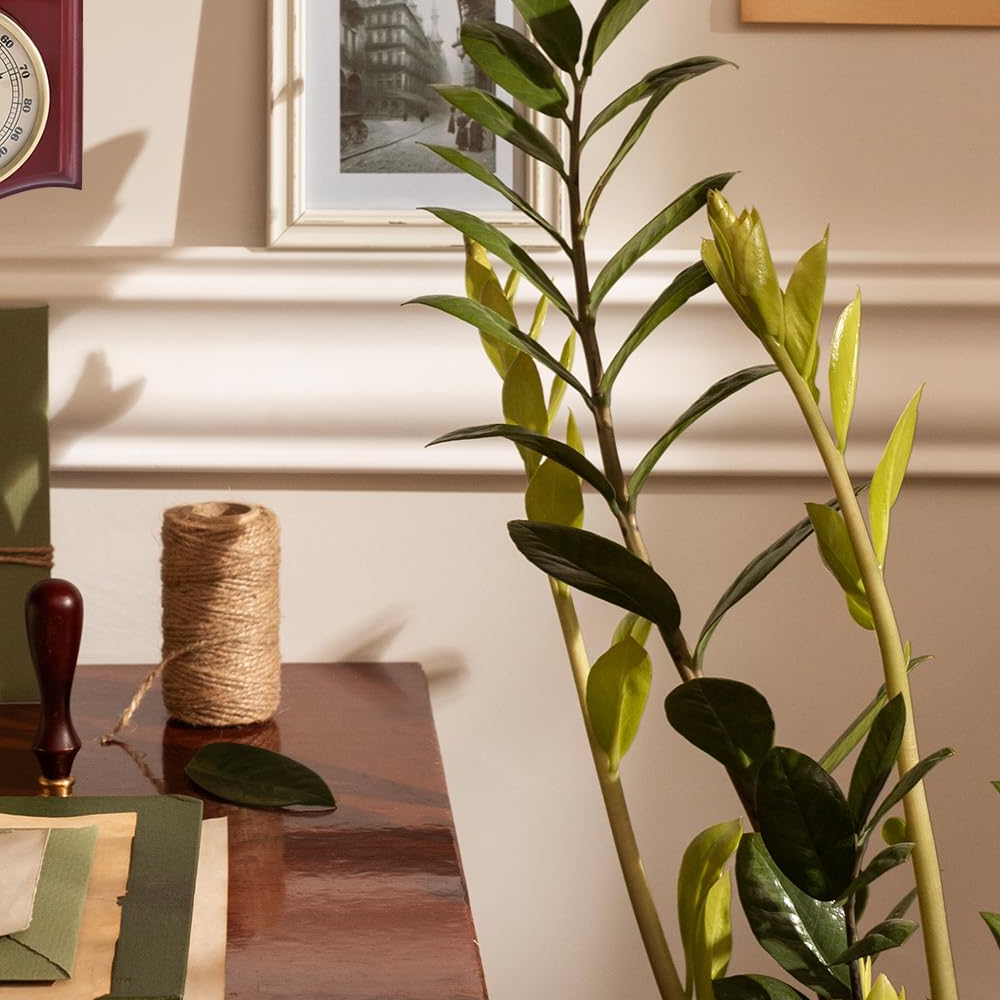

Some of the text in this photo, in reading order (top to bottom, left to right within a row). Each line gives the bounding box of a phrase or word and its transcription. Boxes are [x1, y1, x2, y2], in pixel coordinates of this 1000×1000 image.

[0, 34, 14, 48] 60
[19, 64, 31, 79] 70
[23, 98, 33, 113] 80
[10, 126, 24, 142] 90
